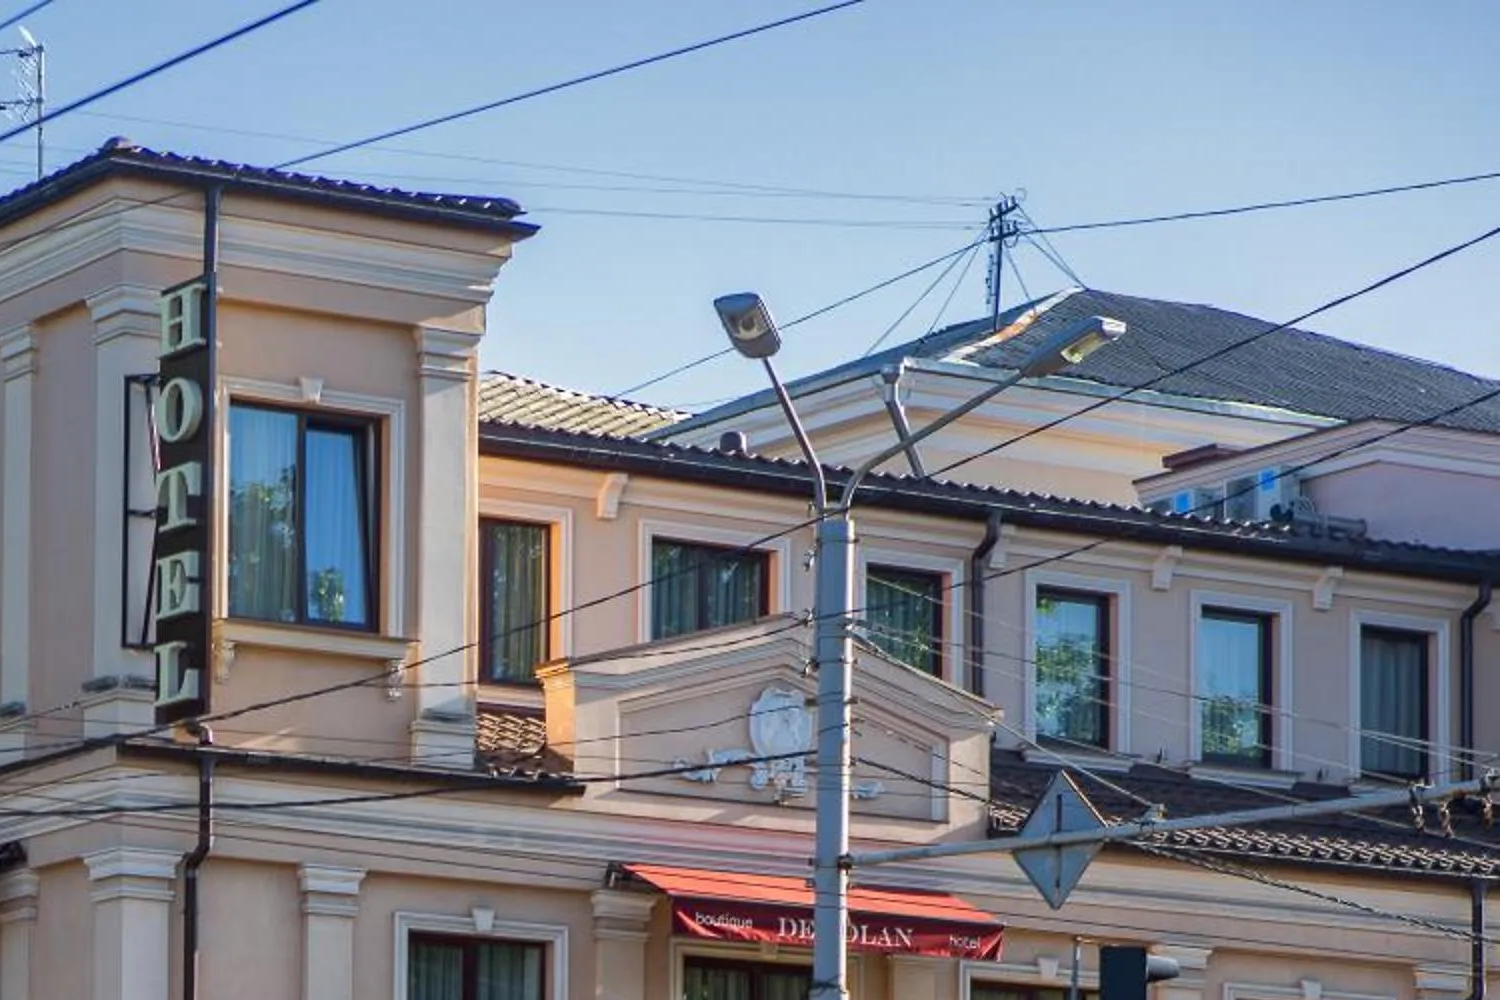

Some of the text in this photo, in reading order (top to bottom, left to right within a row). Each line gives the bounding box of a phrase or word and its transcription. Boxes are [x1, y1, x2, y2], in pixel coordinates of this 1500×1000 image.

[154, 284, 206, 706] HOTEL
[695, 911, 753, 932] boutique
[778, 917, 816, 939] DE
[949, 934, 980, 949] hotel
